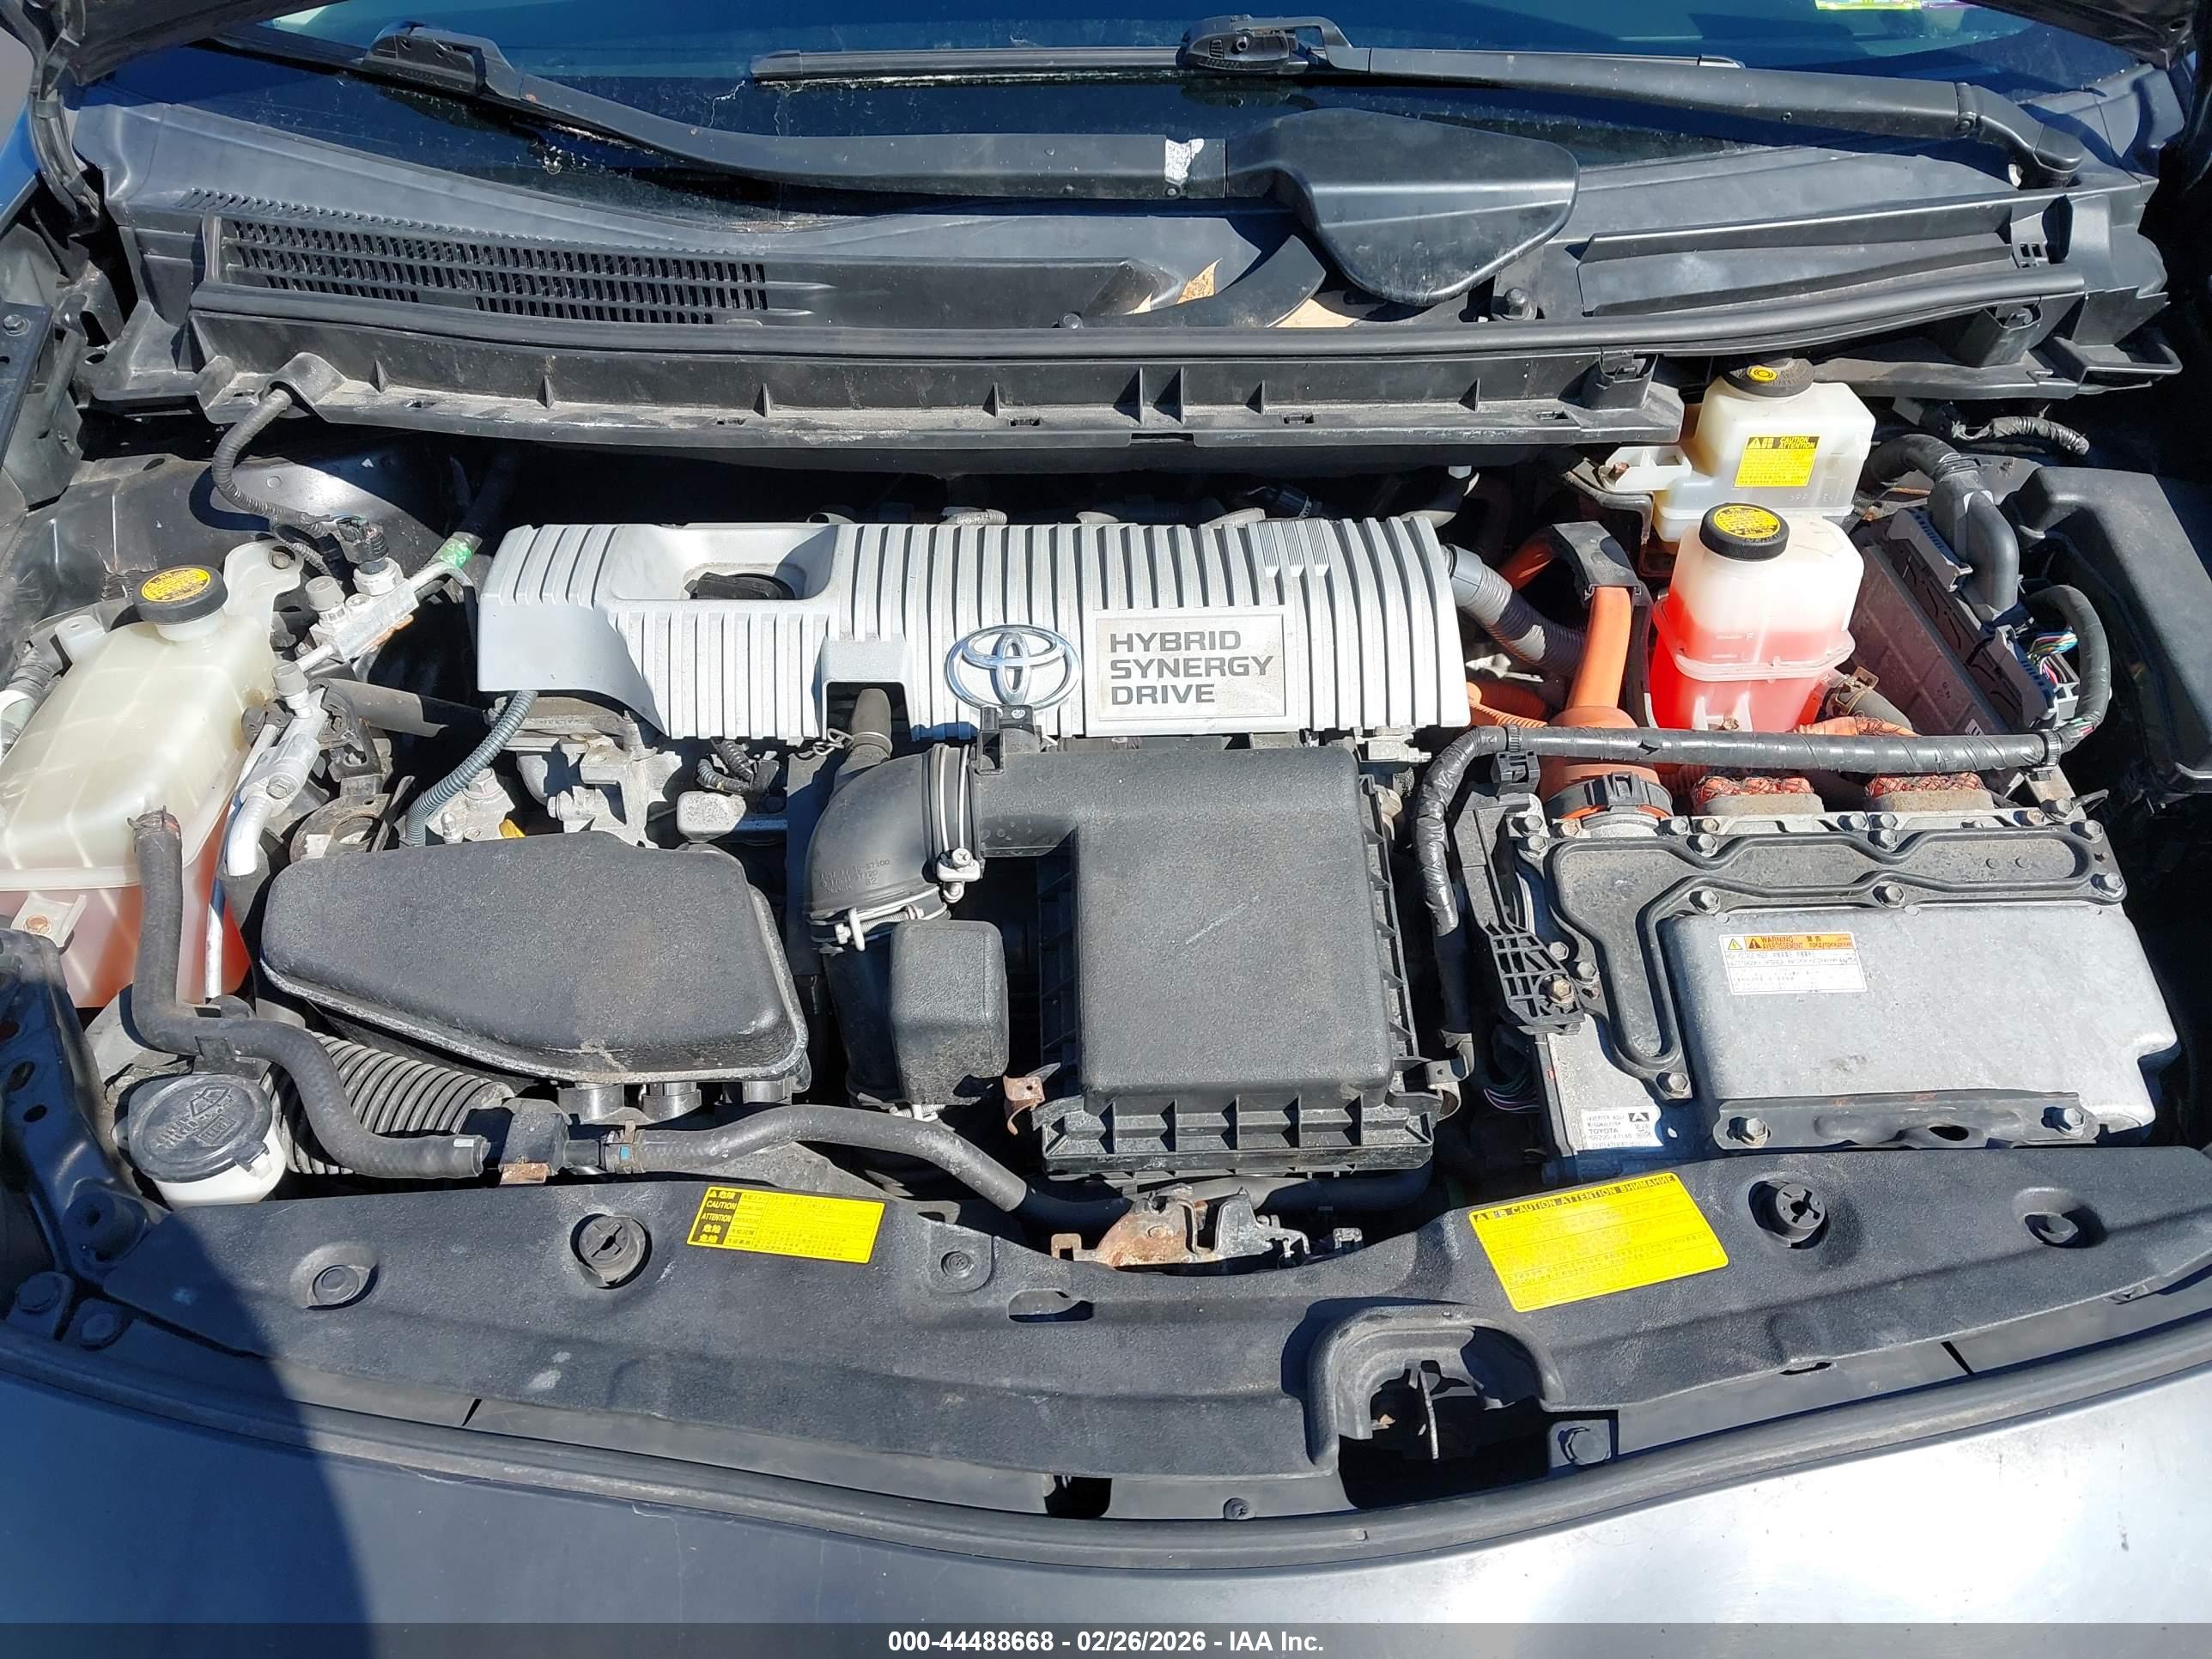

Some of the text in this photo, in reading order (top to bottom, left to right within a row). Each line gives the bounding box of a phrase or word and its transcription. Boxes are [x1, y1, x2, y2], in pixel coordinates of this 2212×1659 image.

[1110, 630, 1242, 653] HYBRID
[1110, 655, 1274, 680] SYNERGY
[1111, 684, 1215, 706] DRIVE
[706, 1200, 737, 1210] CAUTION
[1511, 1199, 1556, 1215] CAUTION
[1560, 1188, 1617, 1205] ATTENTION
[1620, 1175, 1675, 1193] ВНИМАНИЕ
[701, 1212, 732, 1222] ATTENTION
